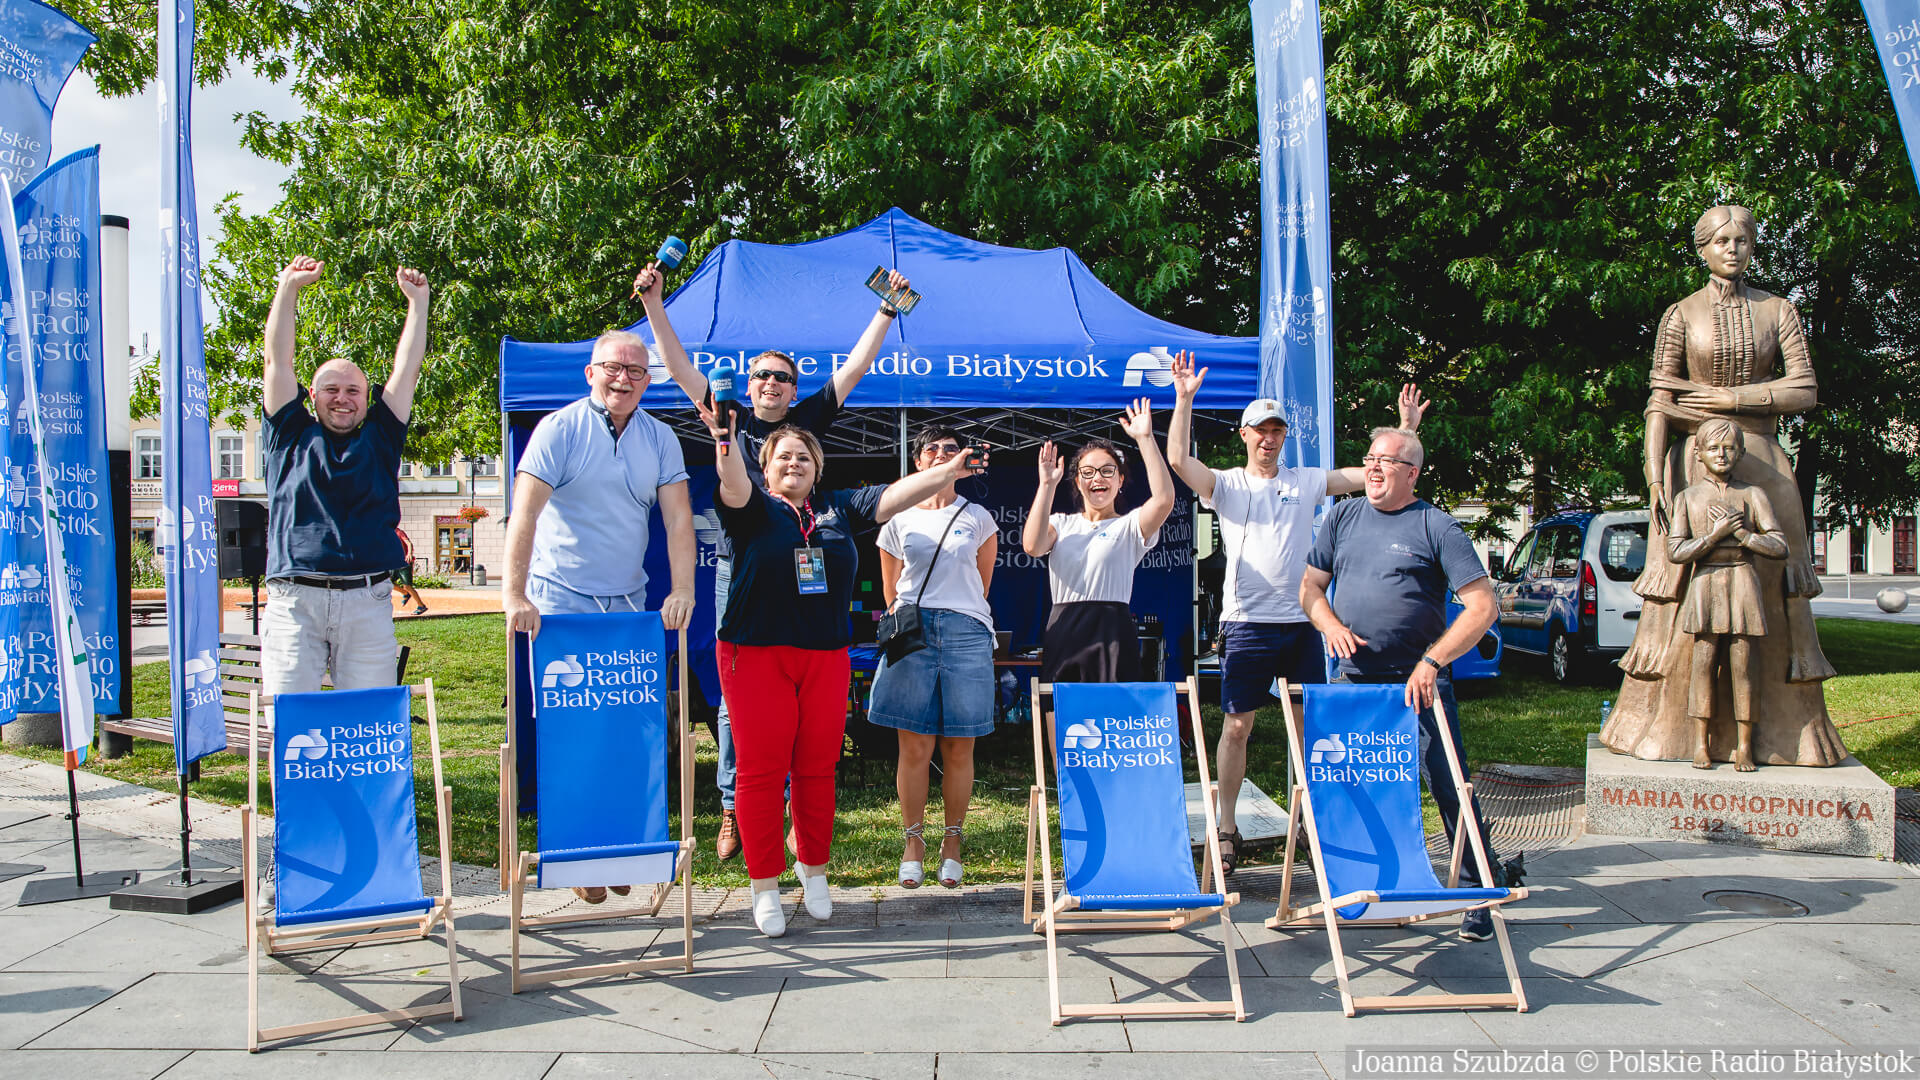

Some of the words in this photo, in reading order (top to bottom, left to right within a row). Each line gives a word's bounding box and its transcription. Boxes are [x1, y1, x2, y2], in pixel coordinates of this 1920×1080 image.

[0, 126, 41, 152] lskie
[0, 149, 35, 169] dio
[39, 214, 81, 228] Pskie
[39, 229, 81, 245] Rdio
[693, 351, 818, 375] Polie
[947, 354, 1109, 383] Białystok
[1162, 518, 1192, 543] Radio
[28, 632, 114, 650] Pokie
[28, 653, 114, 675] Raio
[586, 649, 658, 667] Polskie
[587, 666, 658, 687] Radio
[542, 685, 659, 711] Białystok
[330, 720, 405, 740] Polskie
[1103, 714, 1172, 731] Polskie
[1104, 731, 1173, 749] Radio
[1347, 730, 1412, 745] Polskie
[331, 738, 405, 759] Radio
[1348, 747, 1412, 764] Radio
[283, 755, 407, 781] Białystok
[1063, 748, 1175, 772] Białystok
[1310, 765, 1413, 786] Białystok
[1602, 787, 1684, 809] MARIA
[1693, 793, 1874, 821] KONOPNICKA
[1670, 816, 1724, 833] 1842
[1743, 821, 1799, 837] 1910
